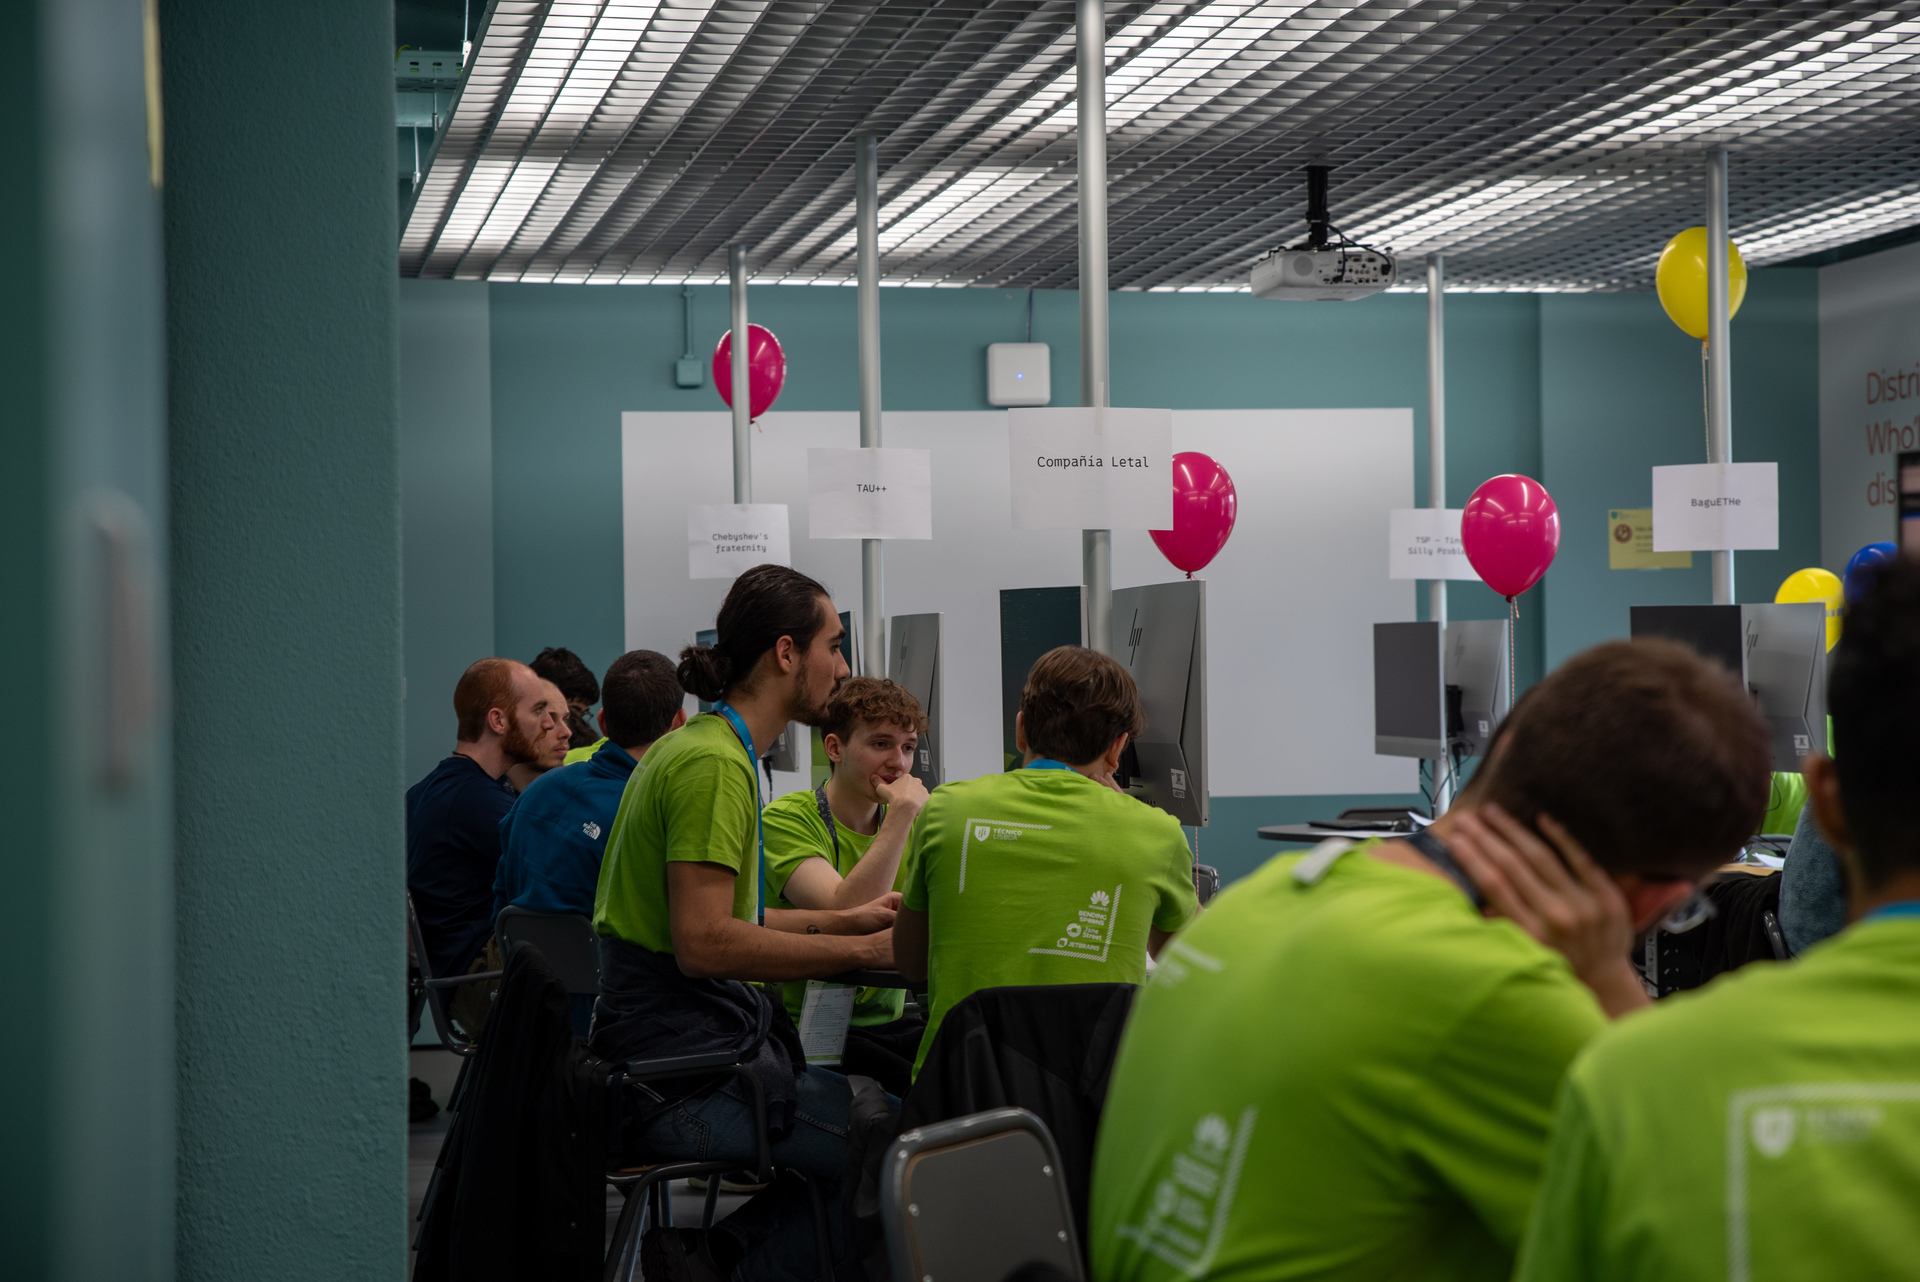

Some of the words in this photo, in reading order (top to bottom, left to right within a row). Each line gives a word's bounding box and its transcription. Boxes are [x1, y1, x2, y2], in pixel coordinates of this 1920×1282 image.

[1866, 362, 1920, 405] Distri
[1037, 455, 1103, 469] Compañía
[1111, 456, 1149, 468] Letal
[856, 483, 887, 493] TAU++
[1867, 472, 1898, 506] dis
[1691, 498, 1741, 508] BaguETHe
[712, 533, 769, 542] Chebyshev's
[715, 544, 767, 554] fraternity
[1408, 546, 1433, 556] Silly
[1437, 547, 1465, 555] Proble
